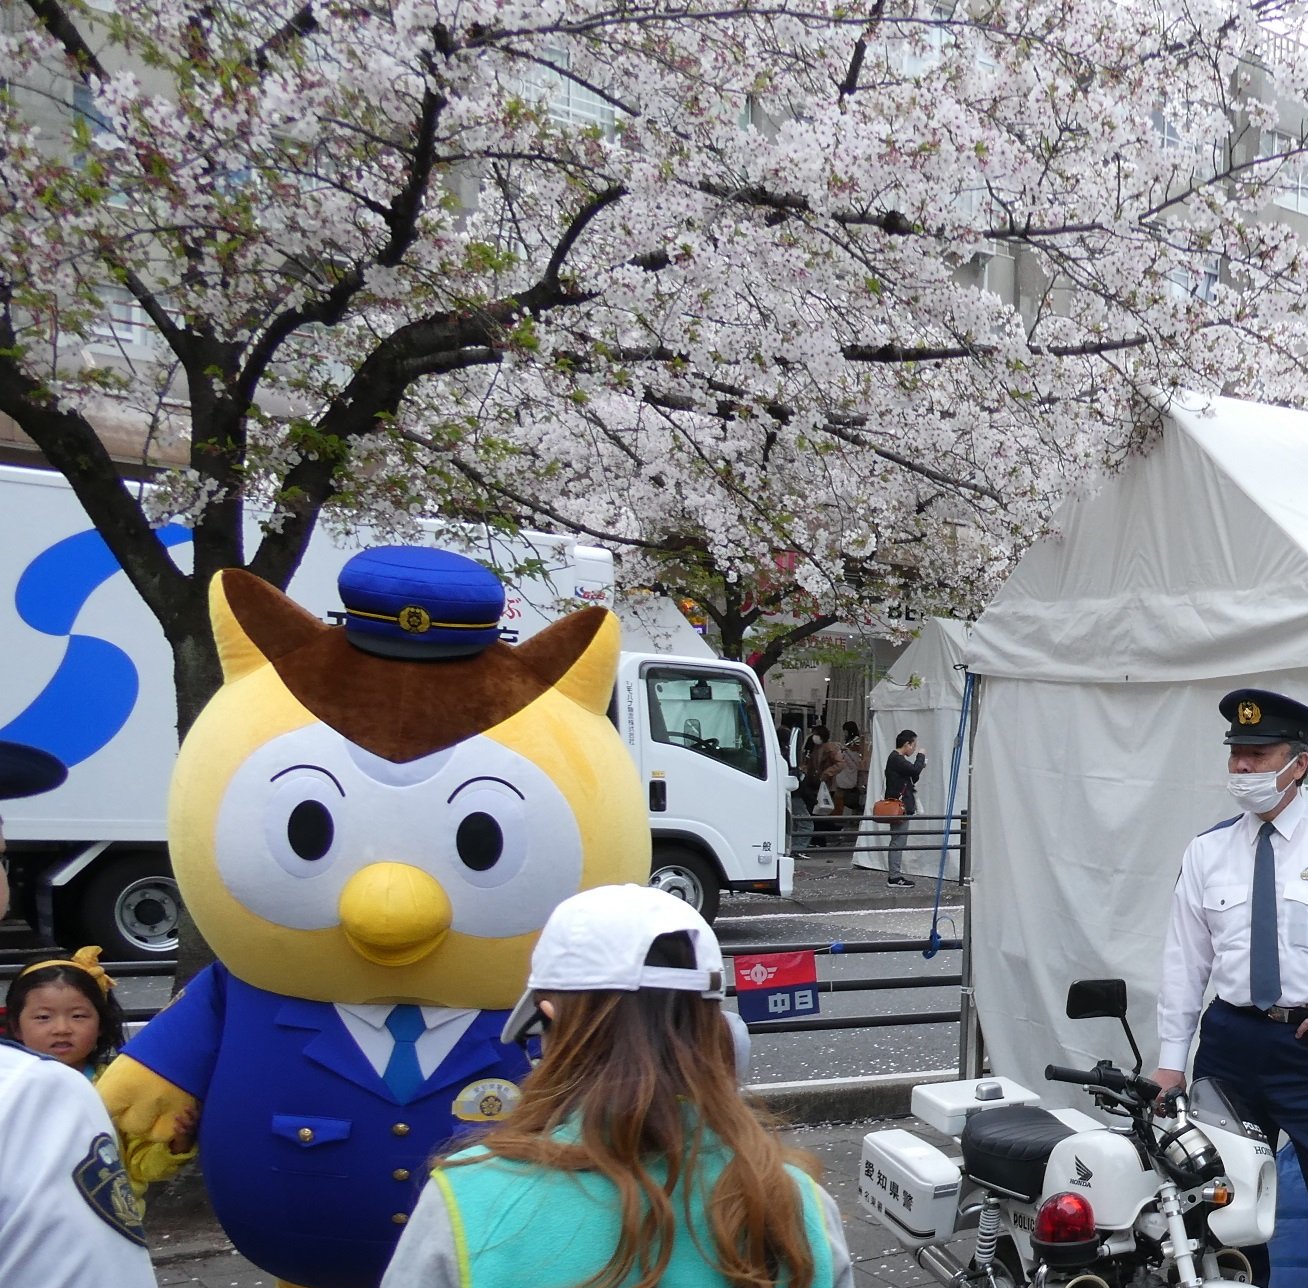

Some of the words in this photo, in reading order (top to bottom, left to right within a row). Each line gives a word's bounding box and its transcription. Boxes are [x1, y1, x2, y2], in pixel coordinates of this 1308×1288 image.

[752, 842, 772, 853] 一般
[768, 989, 813, 1014] 中日
[864, 1159, 915, 1212] 愛知県警
[1069, 1179, 1092, 1188] HONDA
[1013, 1212, 1036, 1232] POLIC
